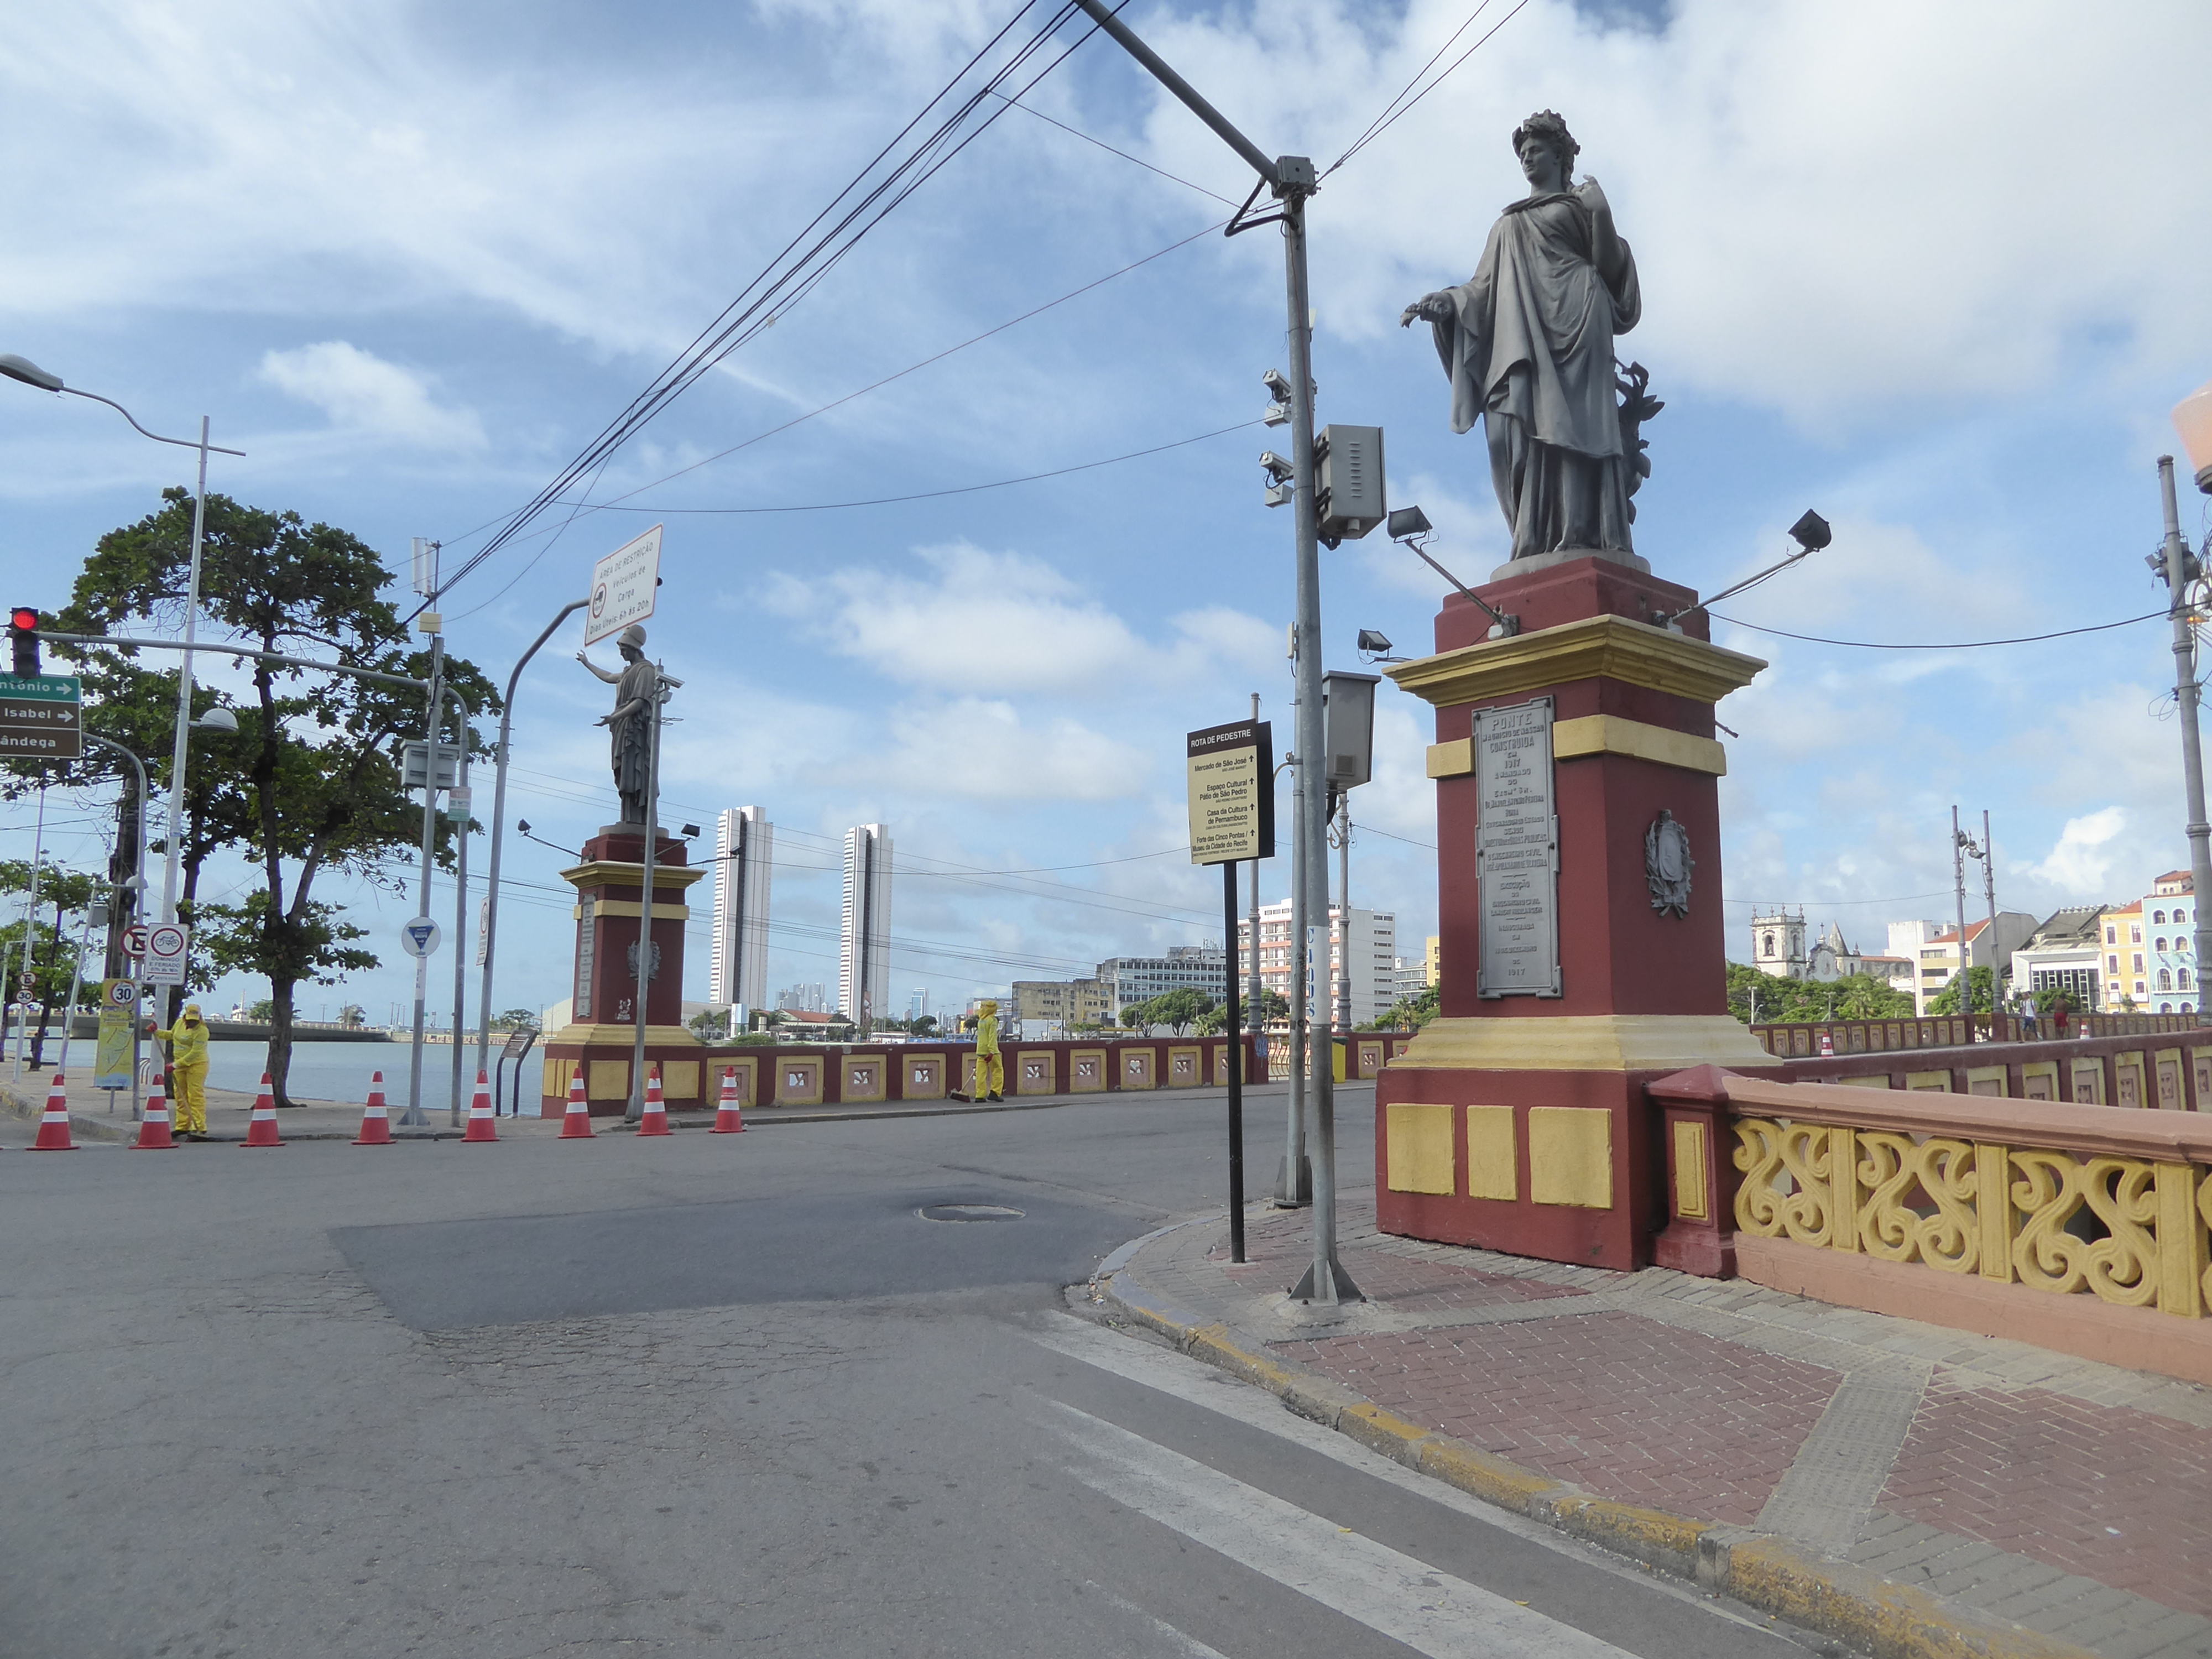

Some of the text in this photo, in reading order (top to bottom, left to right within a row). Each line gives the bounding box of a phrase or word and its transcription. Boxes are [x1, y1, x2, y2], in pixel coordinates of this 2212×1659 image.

[599, 541, 654, 580] ÁREA DE RESTRIÇÃO
[613, 565, 646, 588] Veículos de
[618, 588, 635, 602] Carga
[589, 622, 601, 634] Dias
[619, 610, 627, 619] 6h
[628, 606, 636, 616] às
[637, 599, 649, 612] 20h
[4, 708, 51, 719] Isabel
[1493, 713, 1532, 731] PONTE
[1191, 729, 1251, 748] ROTA DE PEDESTRE
[1490, 736, 1535, 753] CONSTRUIDA
[1194, 763, 1214, 771] Mercado
[1234, 757, 1246, 765] José
[1505, 758, 1521, 769] 1917
[1227, 779, 1247, 788] Cultural
[1215, 814, 1248, 823] Pernambuco
[116, 988, 131, 1000] 30
